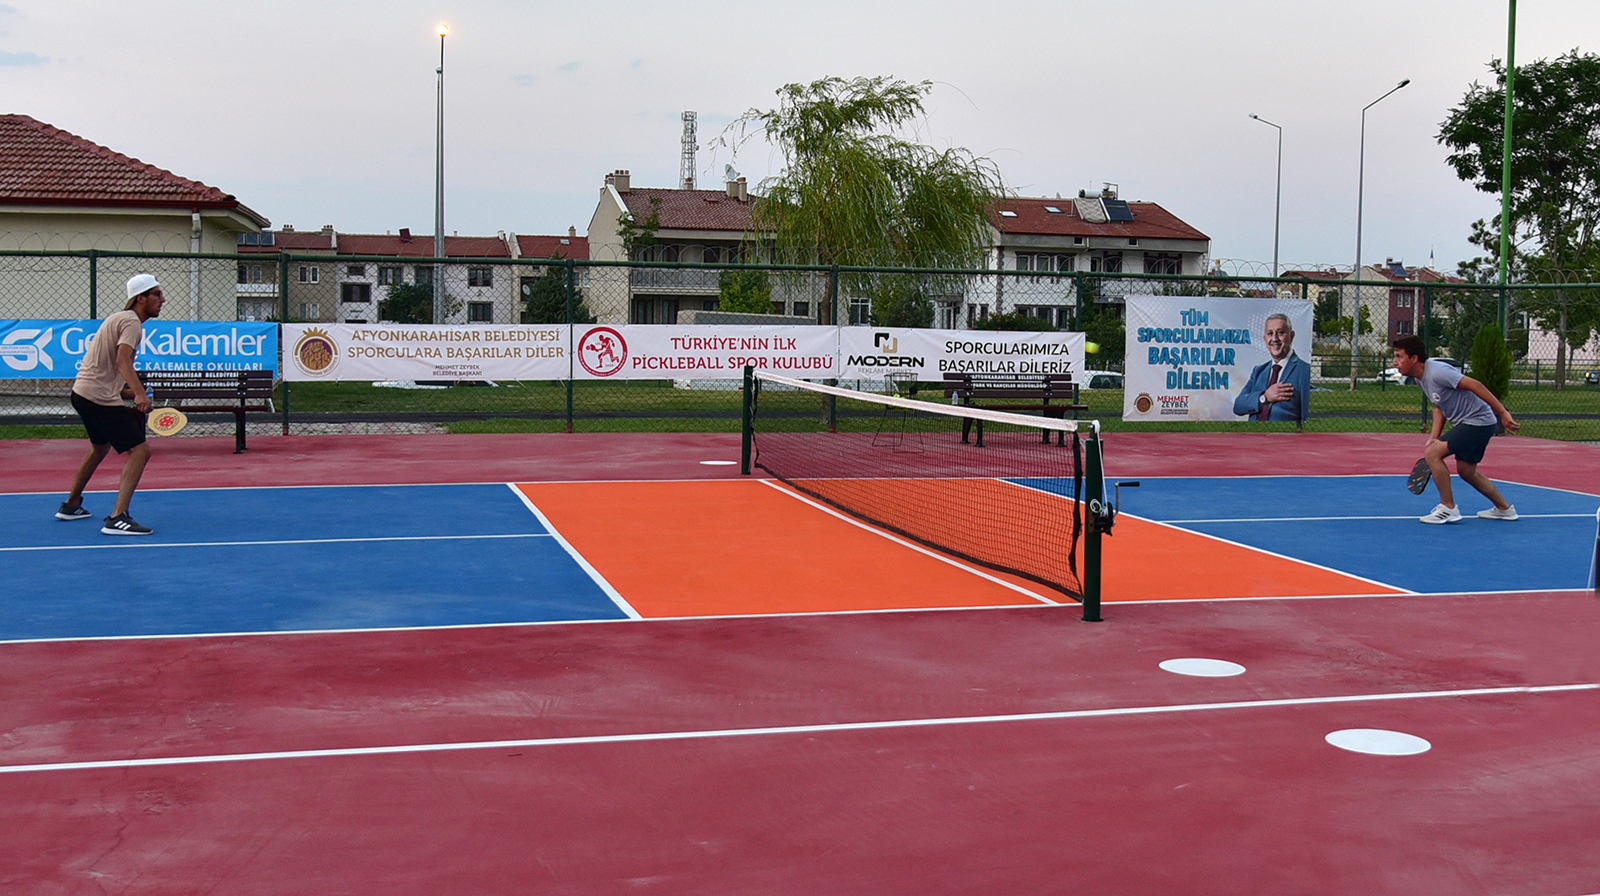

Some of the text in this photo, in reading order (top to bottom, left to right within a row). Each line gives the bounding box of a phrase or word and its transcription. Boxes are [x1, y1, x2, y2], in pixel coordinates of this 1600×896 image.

[1180, 308, 1209, 326] TÜM
[351, 328, 560, 342] AFYONKARAHİSAR BELEDİYESİ
[670, 334, 797, 350] TÜRKİYE'NİN İLK
[1137, 327, 1251, 344] SPORCULARIMIZA
[347, 345, 564, 361] SPORCULARA BAŞARILAR DİLER
[945, 341, 1069, 355] SPORCULARIMIZA
[632, 354, 724, 369] PİCKLEBALL
[728, 356, 768, 369] SPOR
[772, 354, 833, 369] KULUBÜ
[847, 355, 924, 367] MODERN
[1148, 347, 1236, 369] BAŞARILAR
[145, 362, 203, 371] KALEMLER
[207, 362, 263, 371] OKULLARI
[939, 359, 1016, 373] BAŞARILAR
[1166, 367, 1229, 390] DİLERİM
